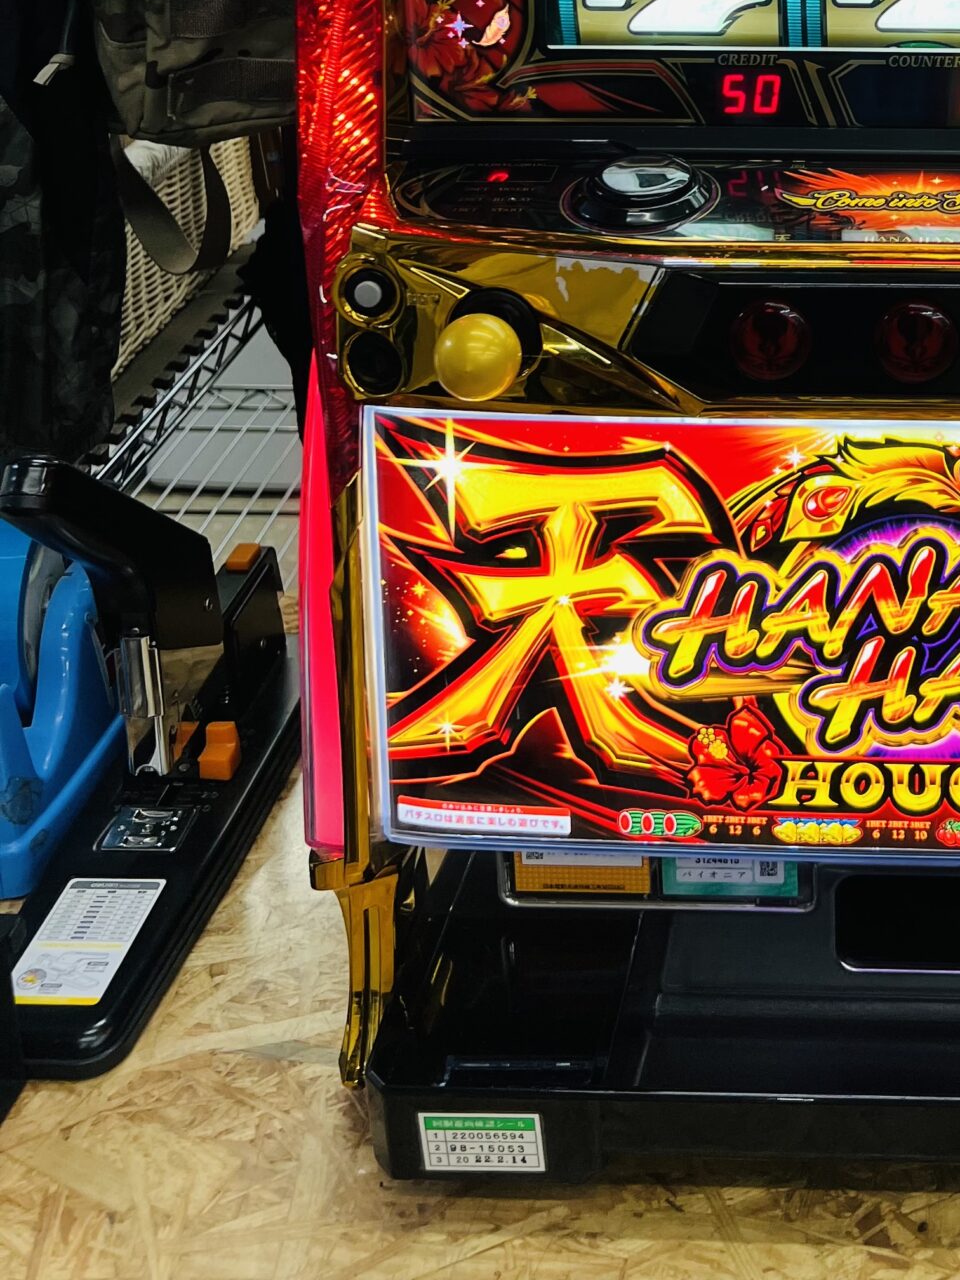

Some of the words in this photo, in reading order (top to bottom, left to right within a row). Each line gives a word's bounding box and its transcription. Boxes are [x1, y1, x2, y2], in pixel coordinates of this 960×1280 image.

[718, 54, 778, 67] CREDIT
[721, 74, 782, 114] 50
[814, 191, 885, 210] Come
[888, 193, 941, 209] into
[709, 824, 718, 834] 6
[729, 825, 742, 835] 12
[752, 826, 761, 835] 6
[872, 829, 880, 839] 6
[892, 830, 905, 839] 12
[914, 830, 928, 840] 10
[682, 870, 746, 879] パイオニア
[452, 1131, 525, 1140] 220056594
[456, 1156, 469, 1164] 20
